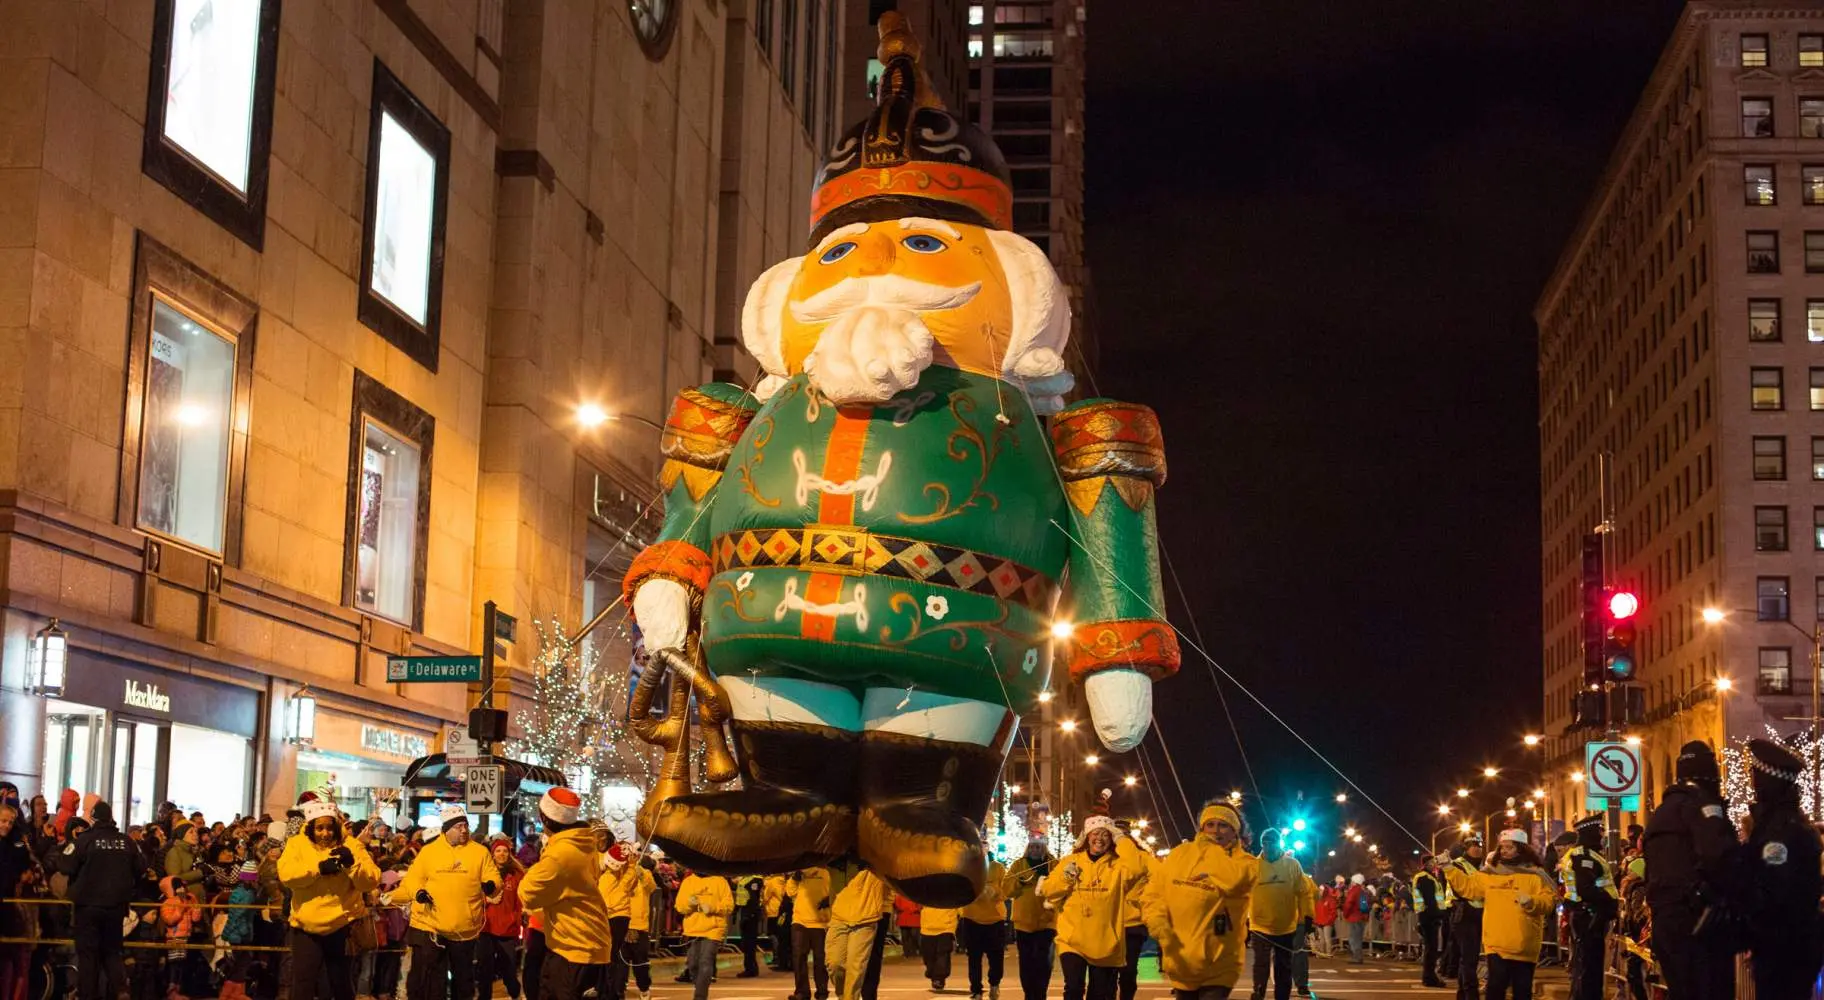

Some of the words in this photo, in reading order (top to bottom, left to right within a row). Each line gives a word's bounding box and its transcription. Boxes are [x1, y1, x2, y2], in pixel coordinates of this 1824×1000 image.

[416, 662, 467, 676] Delaware
[124, 679, 170, 712] MaxMara
[470, 769, 495, 781] ONE
[470, 783, 496, 794] WAY
[95, 839, 125, 850] POLICE
